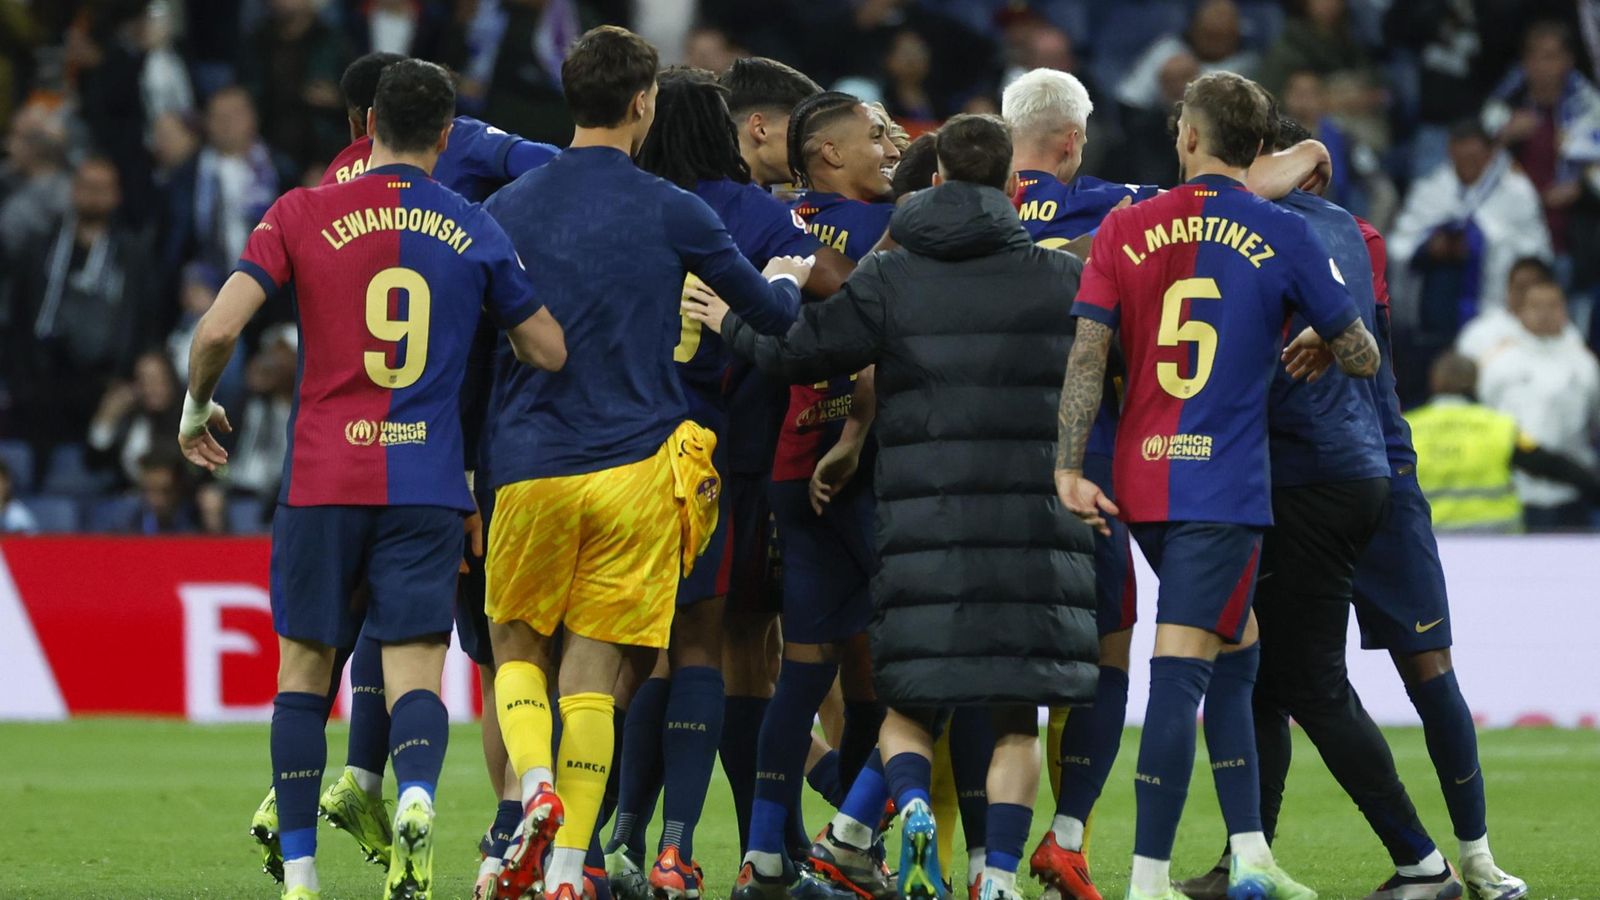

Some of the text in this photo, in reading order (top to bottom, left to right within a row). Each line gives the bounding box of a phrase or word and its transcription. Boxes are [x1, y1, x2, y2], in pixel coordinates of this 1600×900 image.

[1018, 200, 1058, 222] MO
[321, 207, 473, 255] LEWANDOWSKI
[363, 266, 431, 389] 9
[1156, 277, 1222, 400] 5
[380, 421, 427, 434] UNHCR
[379, 430, 427, 443] ACNUR
[1169, 434, 1213, 447] UNHCR
[1167, 444, 1212, 457] ACNUR
